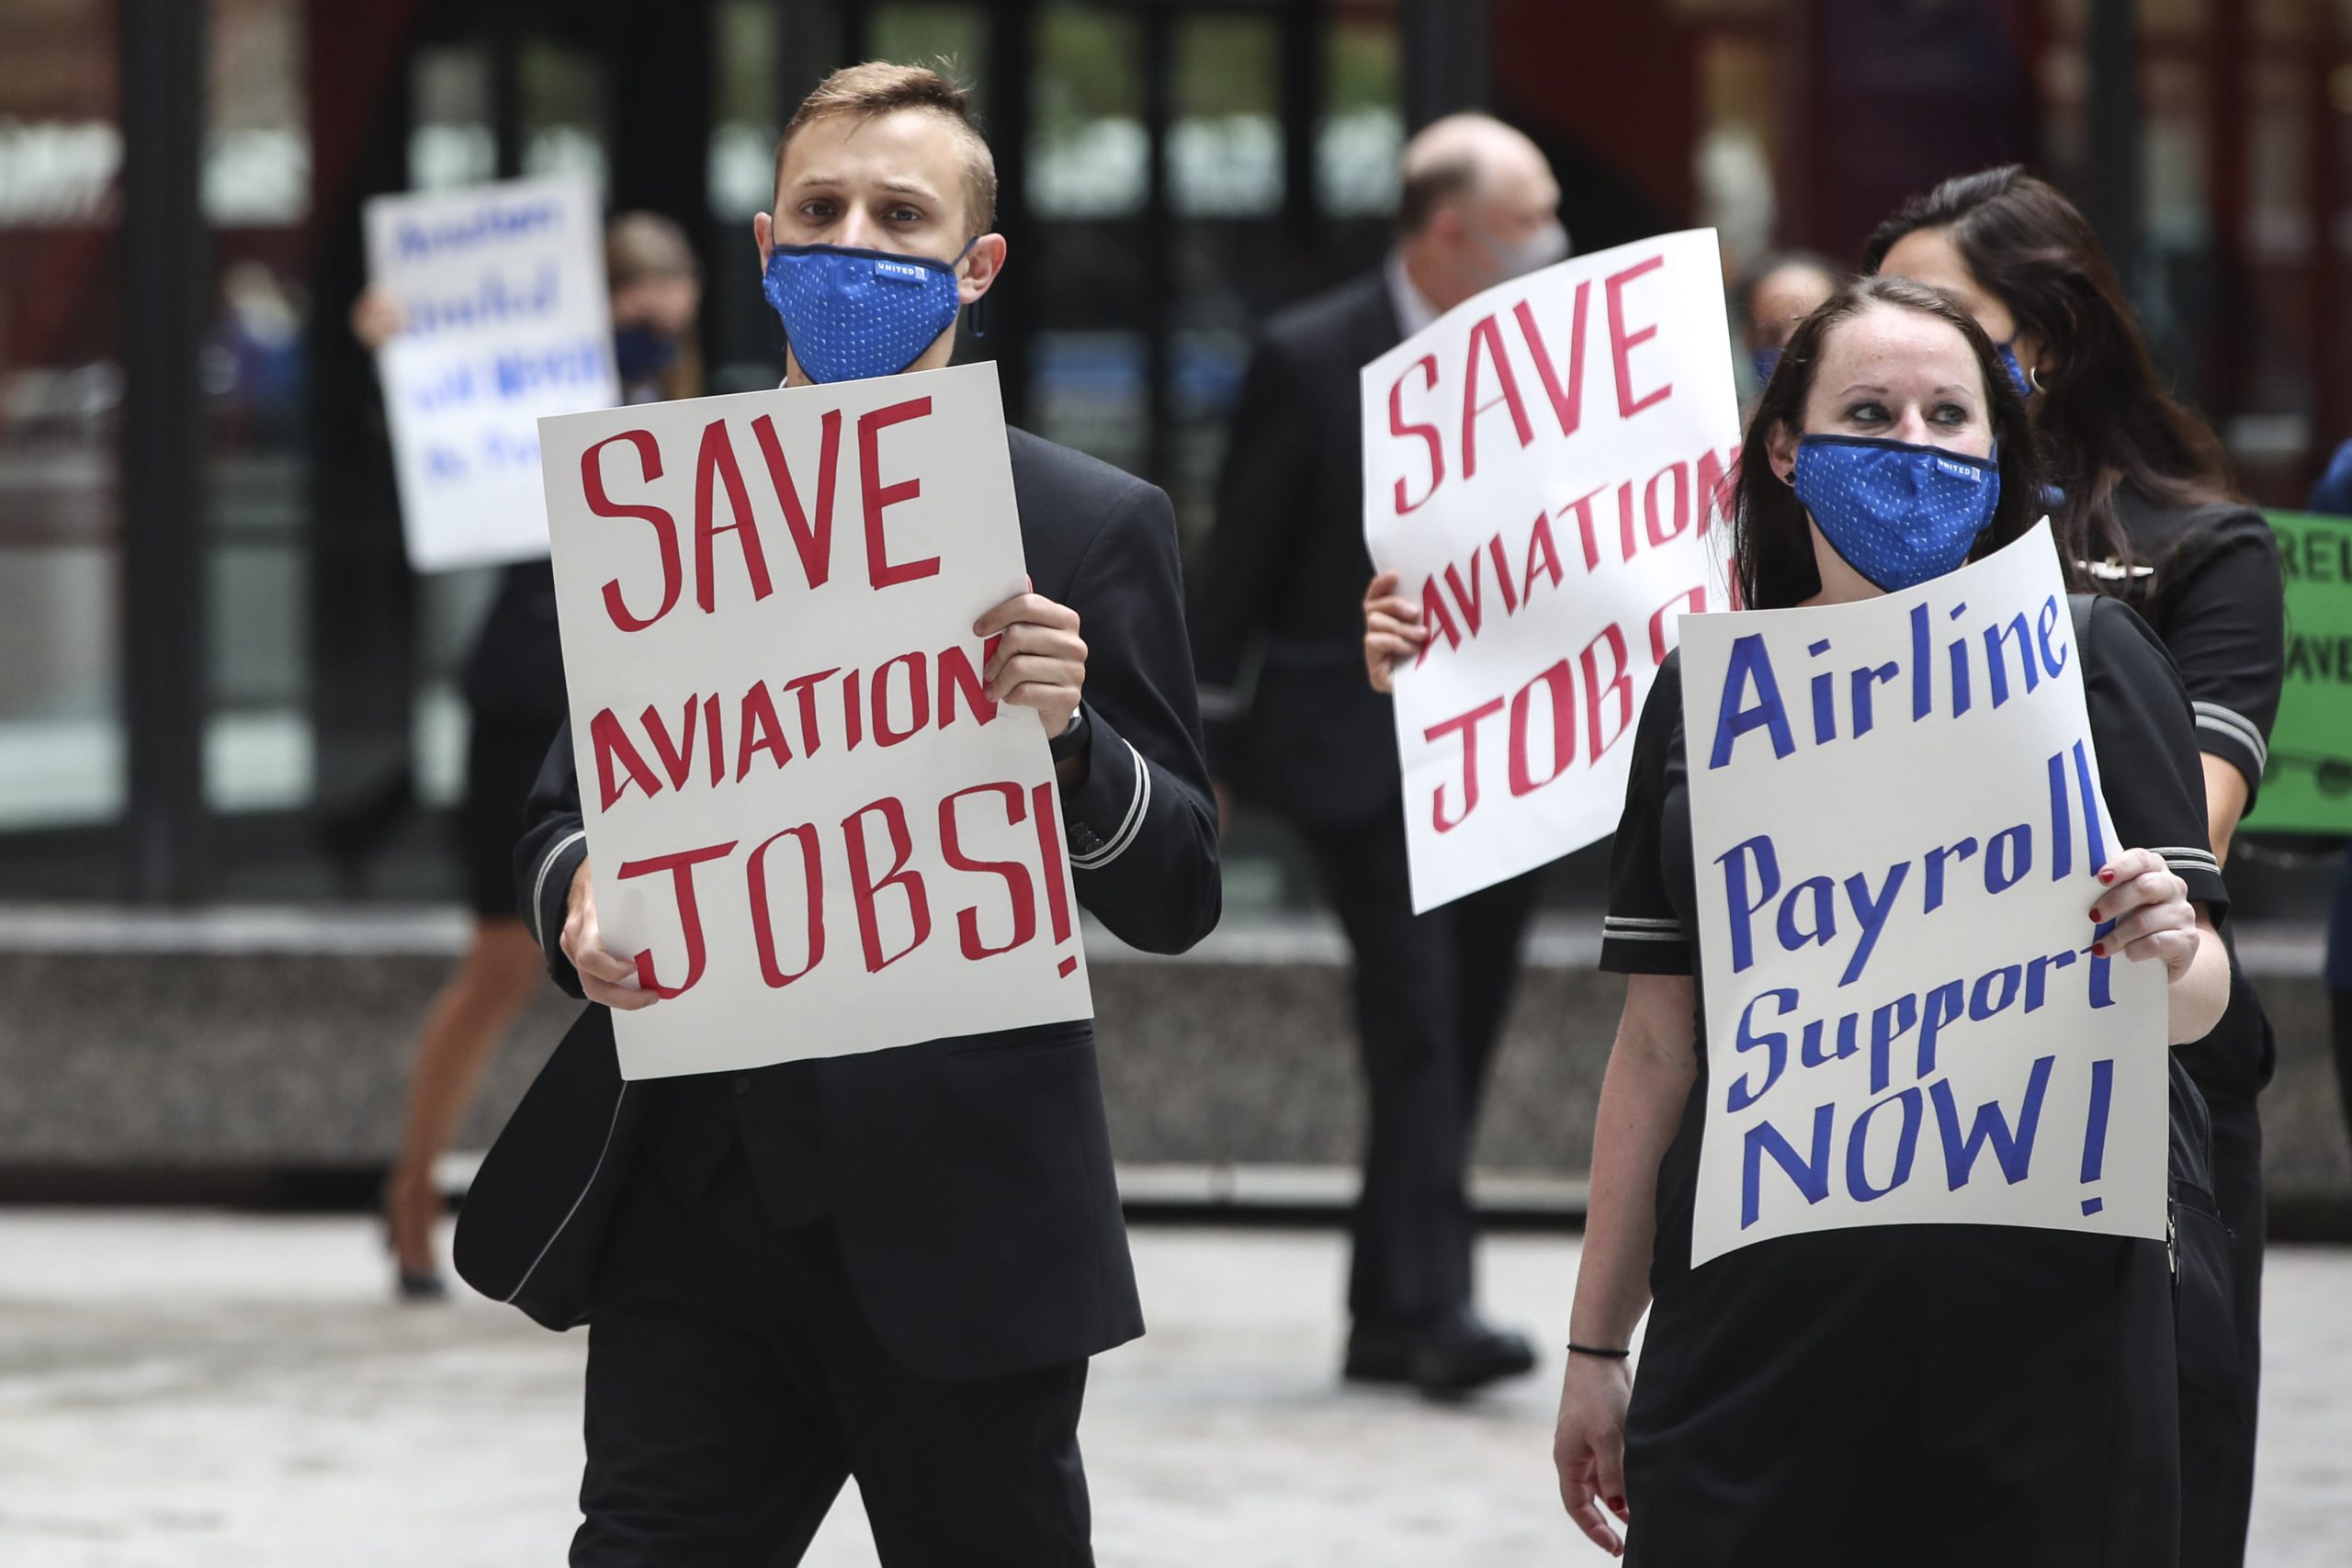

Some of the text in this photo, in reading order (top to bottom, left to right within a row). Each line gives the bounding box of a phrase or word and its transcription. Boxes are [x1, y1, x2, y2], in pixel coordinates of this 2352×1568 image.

[877, 262, 915, 276] UNITED
[1388, 254, 1674, 517] SAVE
[1937, 458, 1972, 476] UNITED
[580, 395, 941, 633] SAVE
[1416, 446, 1746, 671] AVIATION
[590, 633, 1002, 814] AVIATION
[1708, 593, 2068, 771] Airline
[617, 781, 1077, 1000] JOBS!
[1714, 738, 2107, 988] Payroll
[1726, 917, 2117, 1113] Support
